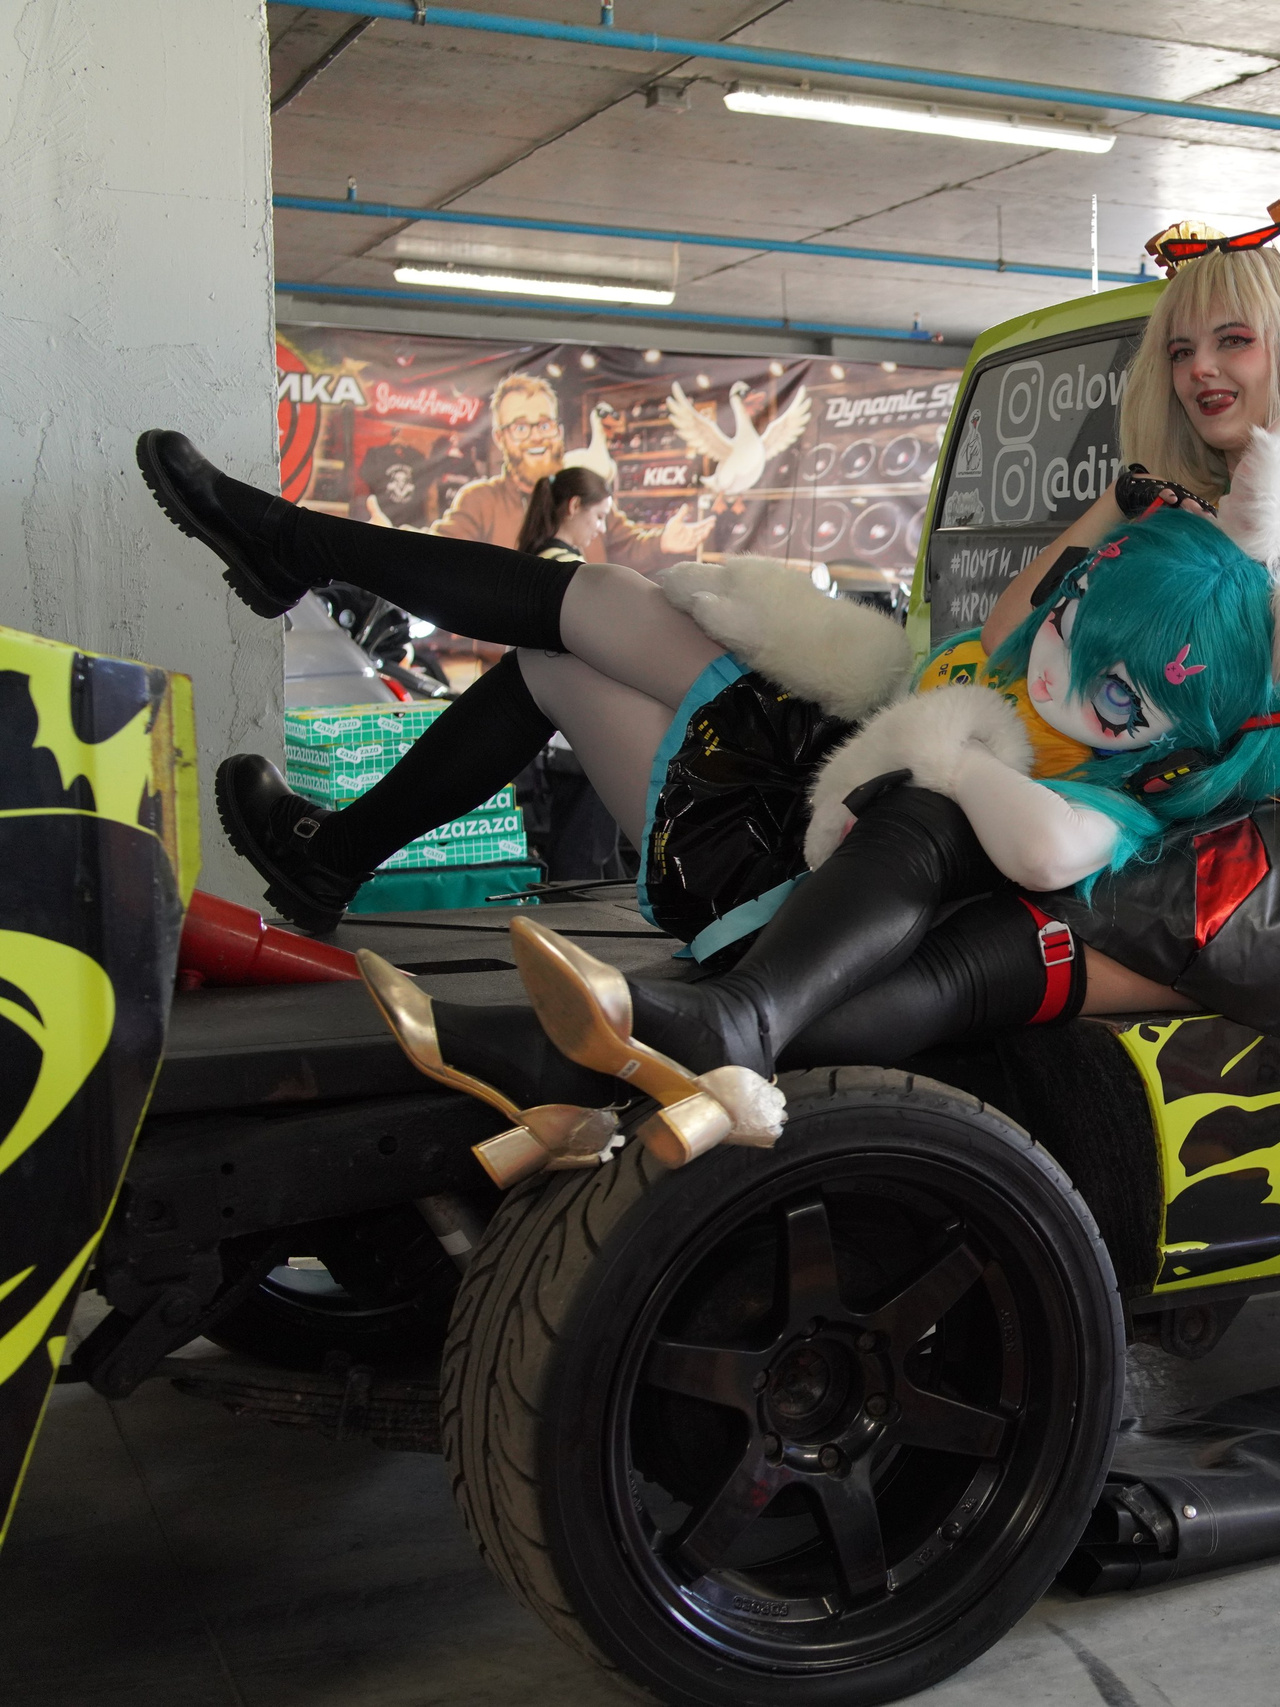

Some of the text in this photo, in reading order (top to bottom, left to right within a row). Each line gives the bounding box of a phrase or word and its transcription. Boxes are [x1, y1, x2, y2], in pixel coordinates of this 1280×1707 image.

[825, 388, 928, 428] Dynamic
[642, 465, 688, 486] KICX
[950, 545, 1050, 579] #ПОЧТИ_Ш
